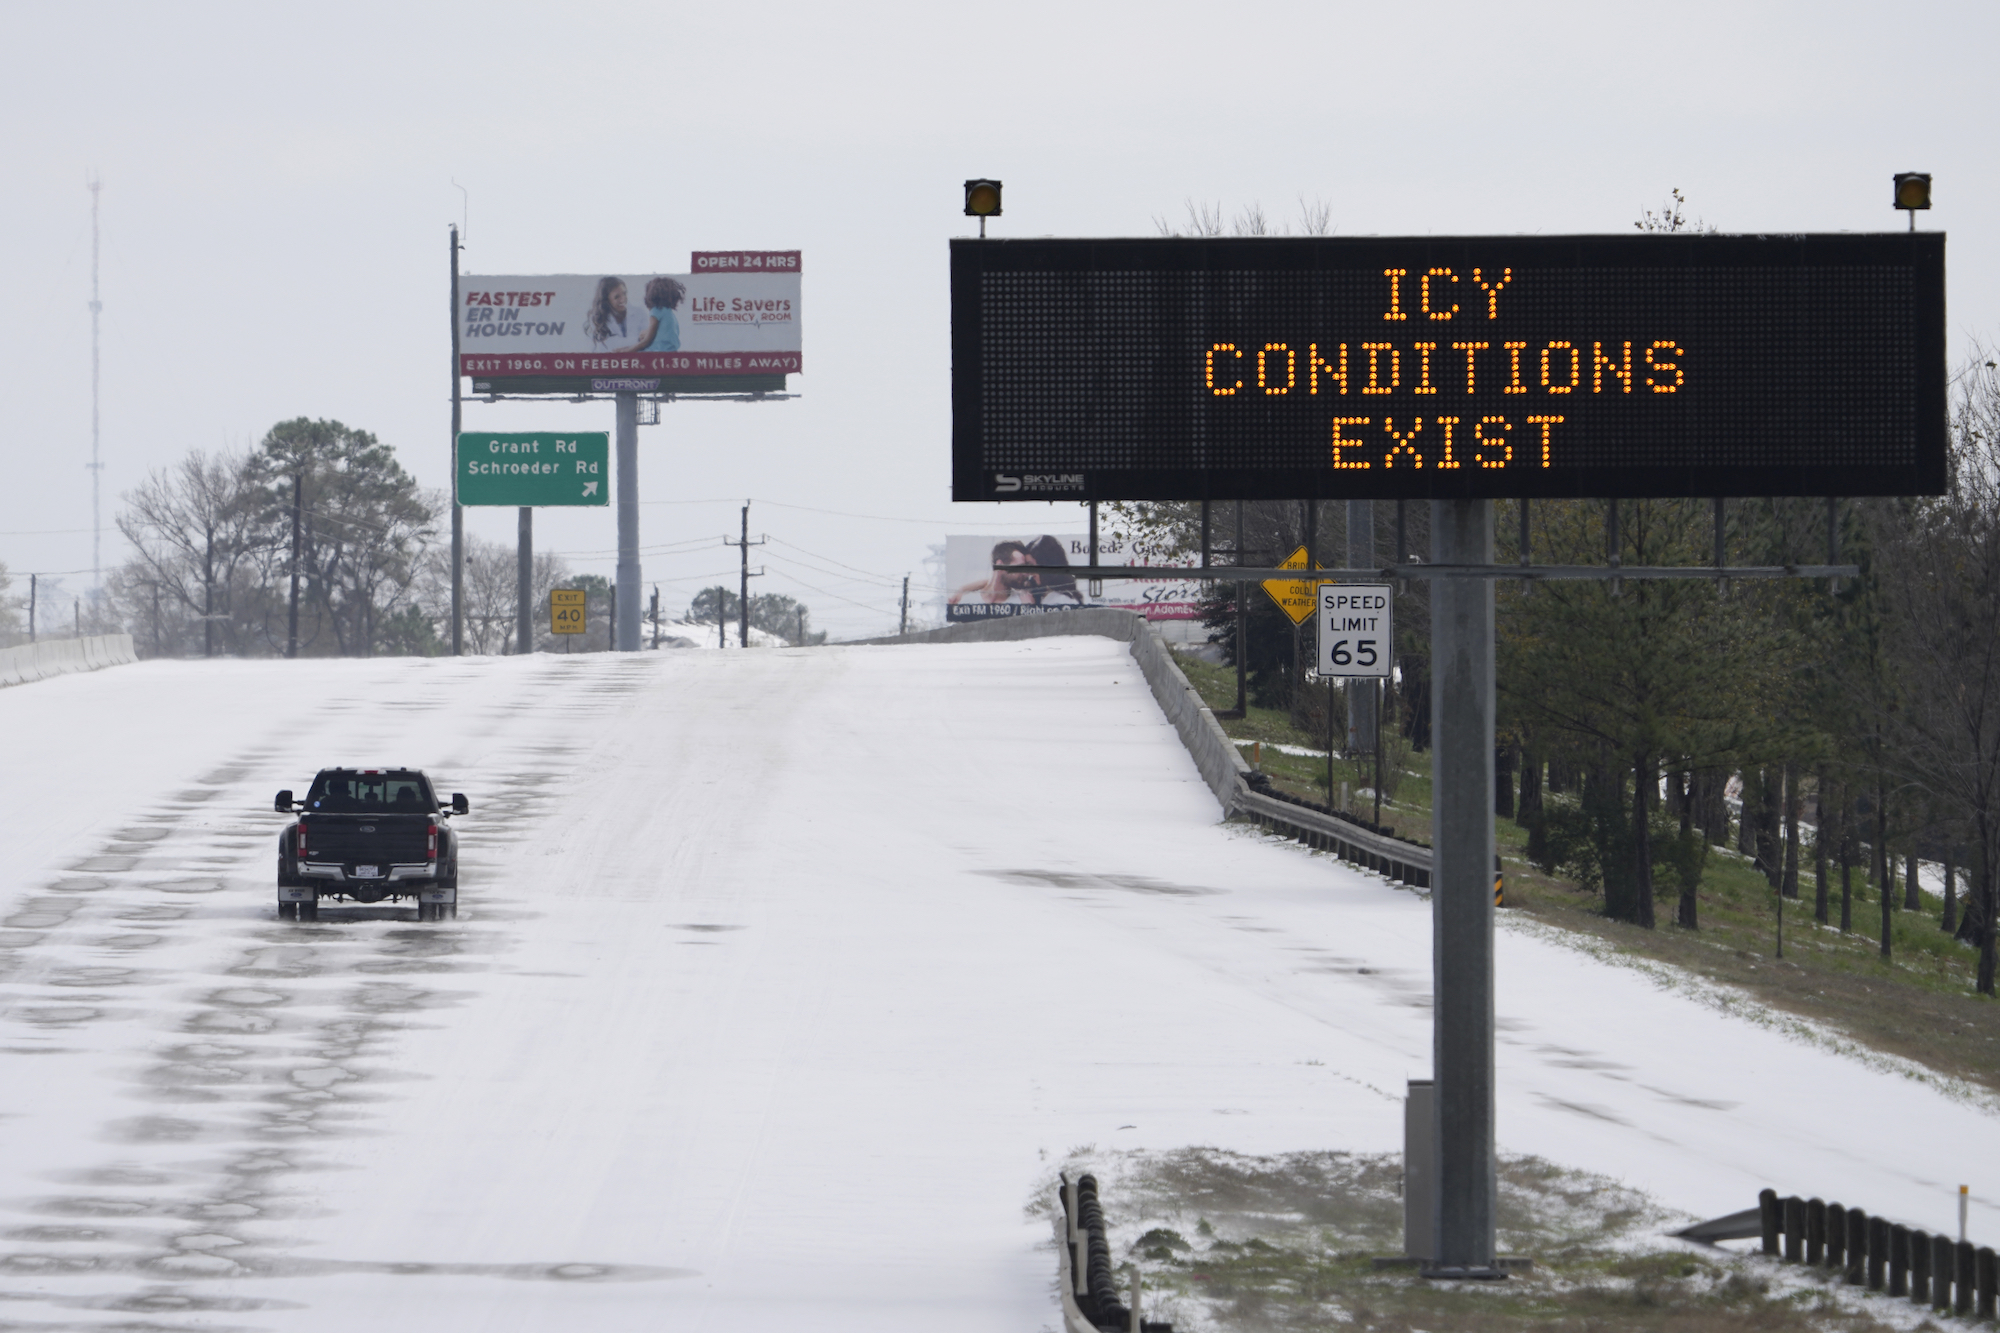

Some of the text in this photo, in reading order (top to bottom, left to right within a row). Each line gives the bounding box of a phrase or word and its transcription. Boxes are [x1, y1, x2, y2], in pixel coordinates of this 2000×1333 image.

[698, 255, 797, 268] OPEN 24 HRS
[465, 291, 556, 307] FASTEST
[1382, 266, 1513, 321] ICY
[692, 296, 791, 312] Life Savers
[465, 307, 520, 322] ER IN
[692, 312, 792, 322] EMERGENCY ROOM
[465, 322, 565, 337] HOUSTON
[466, 359, 501, 371] EXIT
[554, 359, 575, 370] ON
[652, 357, 690, 370] (1.30
[696, 357, 742, 370] MILES
[748, 357, 798, 369] AWAY)
[1204, 339, 1686, 396] CONDITIONS
[594, 379, 657, 391] OUTFRONT
[489, 440, 577, 453] Grant Rd
[1330, 414, 1565, 470] EXIST
[468, 460, 598, 475] Schroeder Rd
[1023, 474, 1085, 483] SKYLINE
[1070, 540, 1124, 554] Boed?
[1289, 586, 1309, 595] COLD
[1281, 598, 1317, 607] WEATHER
[1325, 595, 1386, 609] SPEED
[557, 609, 580, 622] 40
[953, 604, 971, 615] Exit
[972, 605, 987, 615] FM
[989, 604, 1011, 616] 1960
[1331, 618, 1378, 631] LIMIT
[1331, 640, 1378, 667] 65
